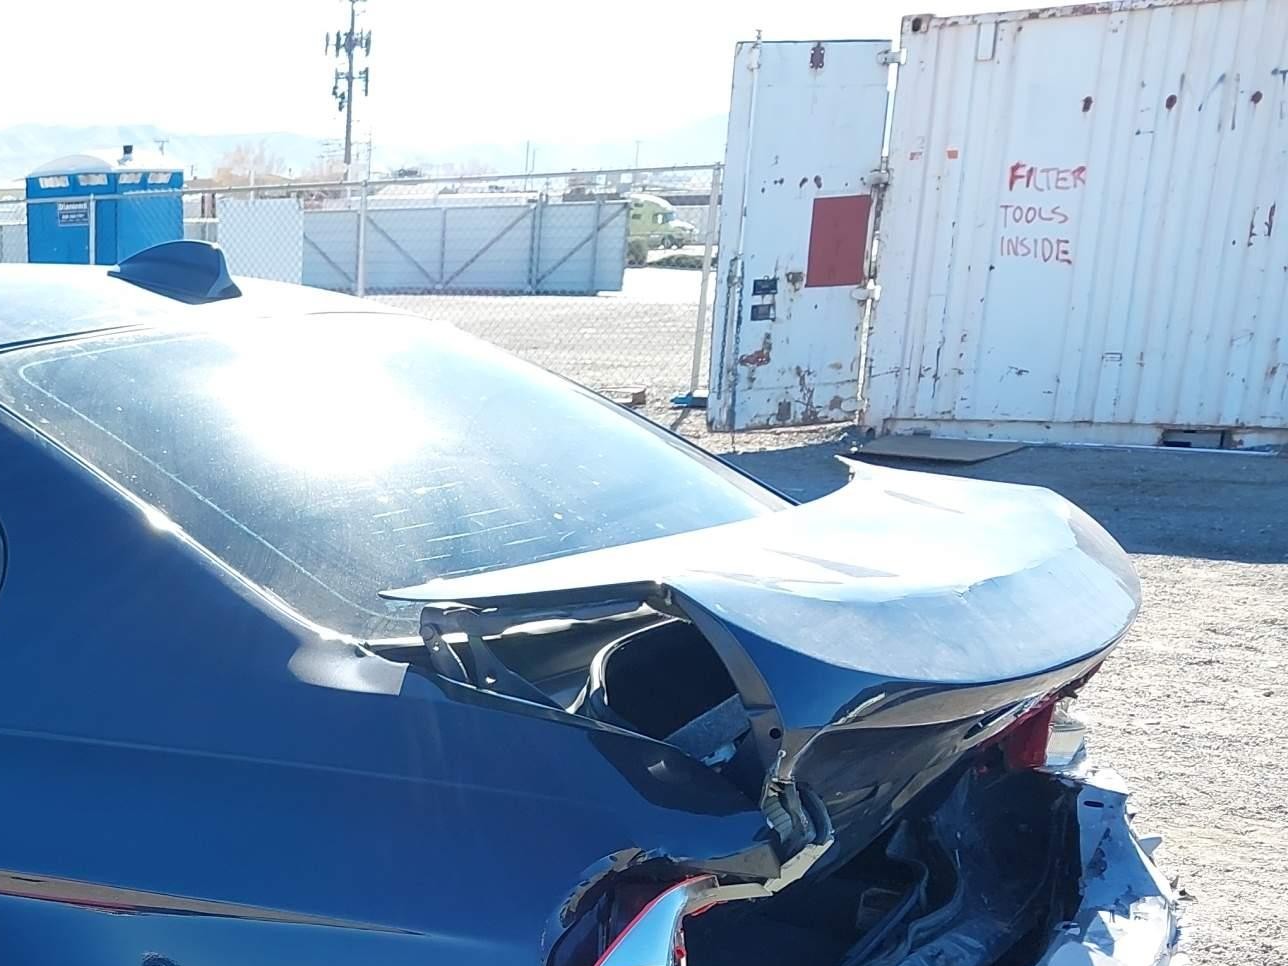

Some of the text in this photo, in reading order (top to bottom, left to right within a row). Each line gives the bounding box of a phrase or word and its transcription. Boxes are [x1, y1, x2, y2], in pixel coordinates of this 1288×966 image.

[1008, 162, 1087, 192] FILTER
[999, 205, 1069, 229] TOOLS
[1000, 236, 1073, 265] INSIDE
